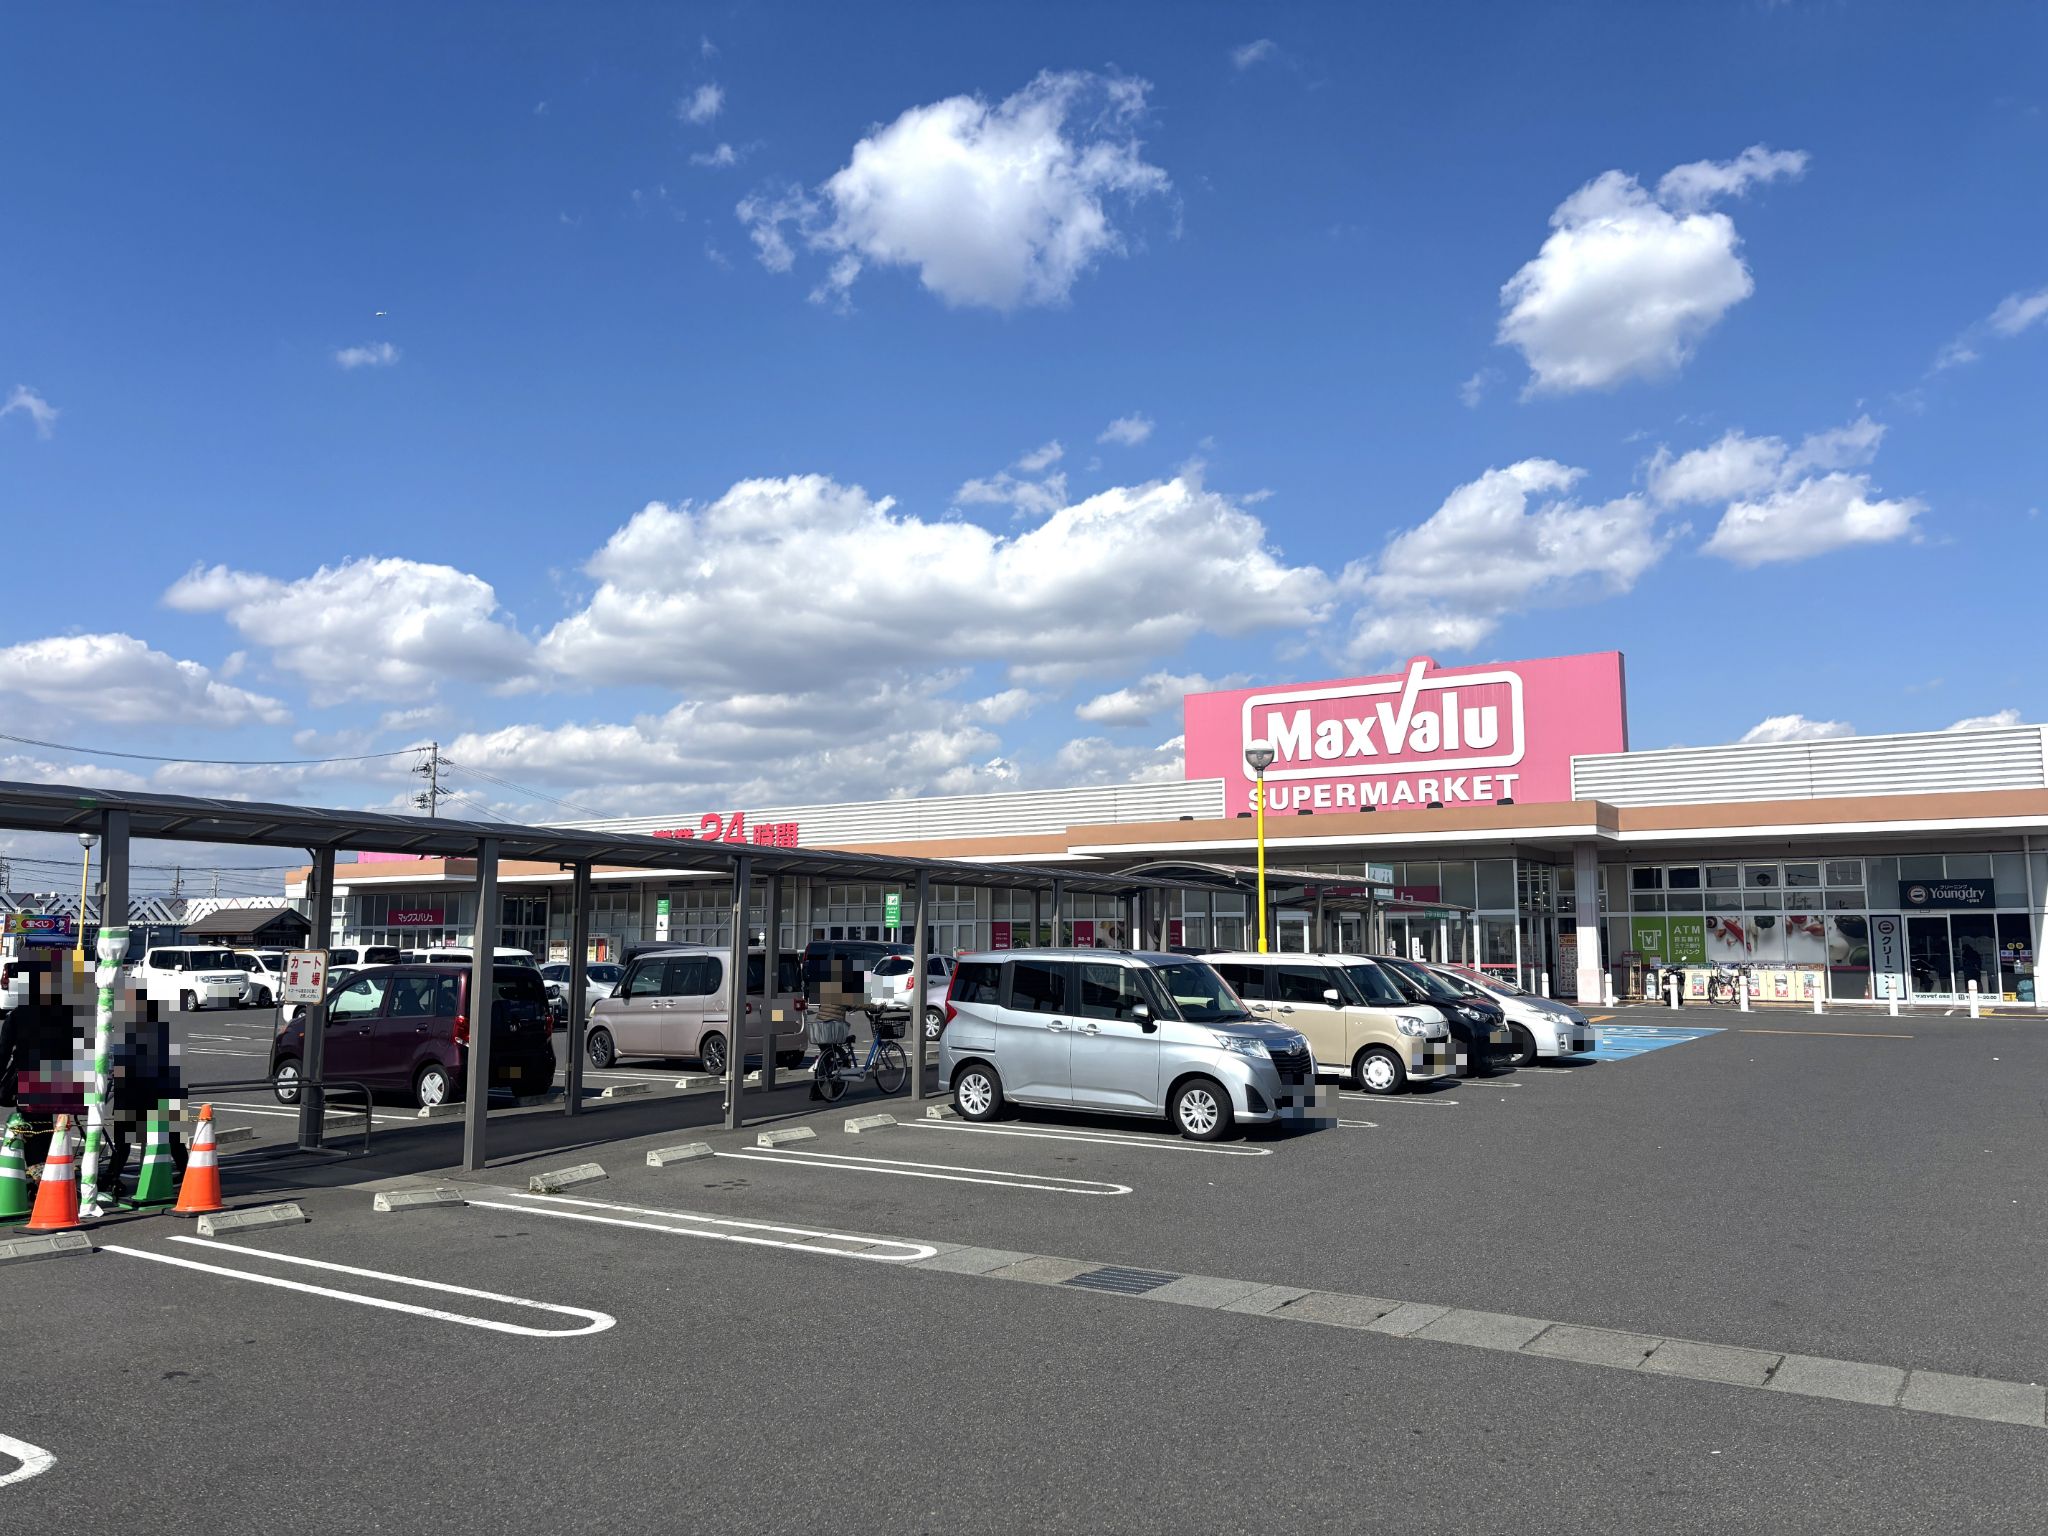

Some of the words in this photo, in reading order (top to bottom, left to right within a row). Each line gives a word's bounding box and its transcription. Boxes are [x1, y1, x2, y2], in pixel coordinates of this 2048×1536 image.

[1268, 661, 1499, 763] MaxValu
[1248, 774, 1519, 811] SUPERMARKET
[1930, 887, 1985, 900] Youngdry
[26, 920, 50, 928] 宝くじ
[398, 913, 433, 922] マックスバリュ
[1674, 925, 1700, 934] ATM
[291, 955, 321, 969] カート
[290, 971, 321, 986] 置場
